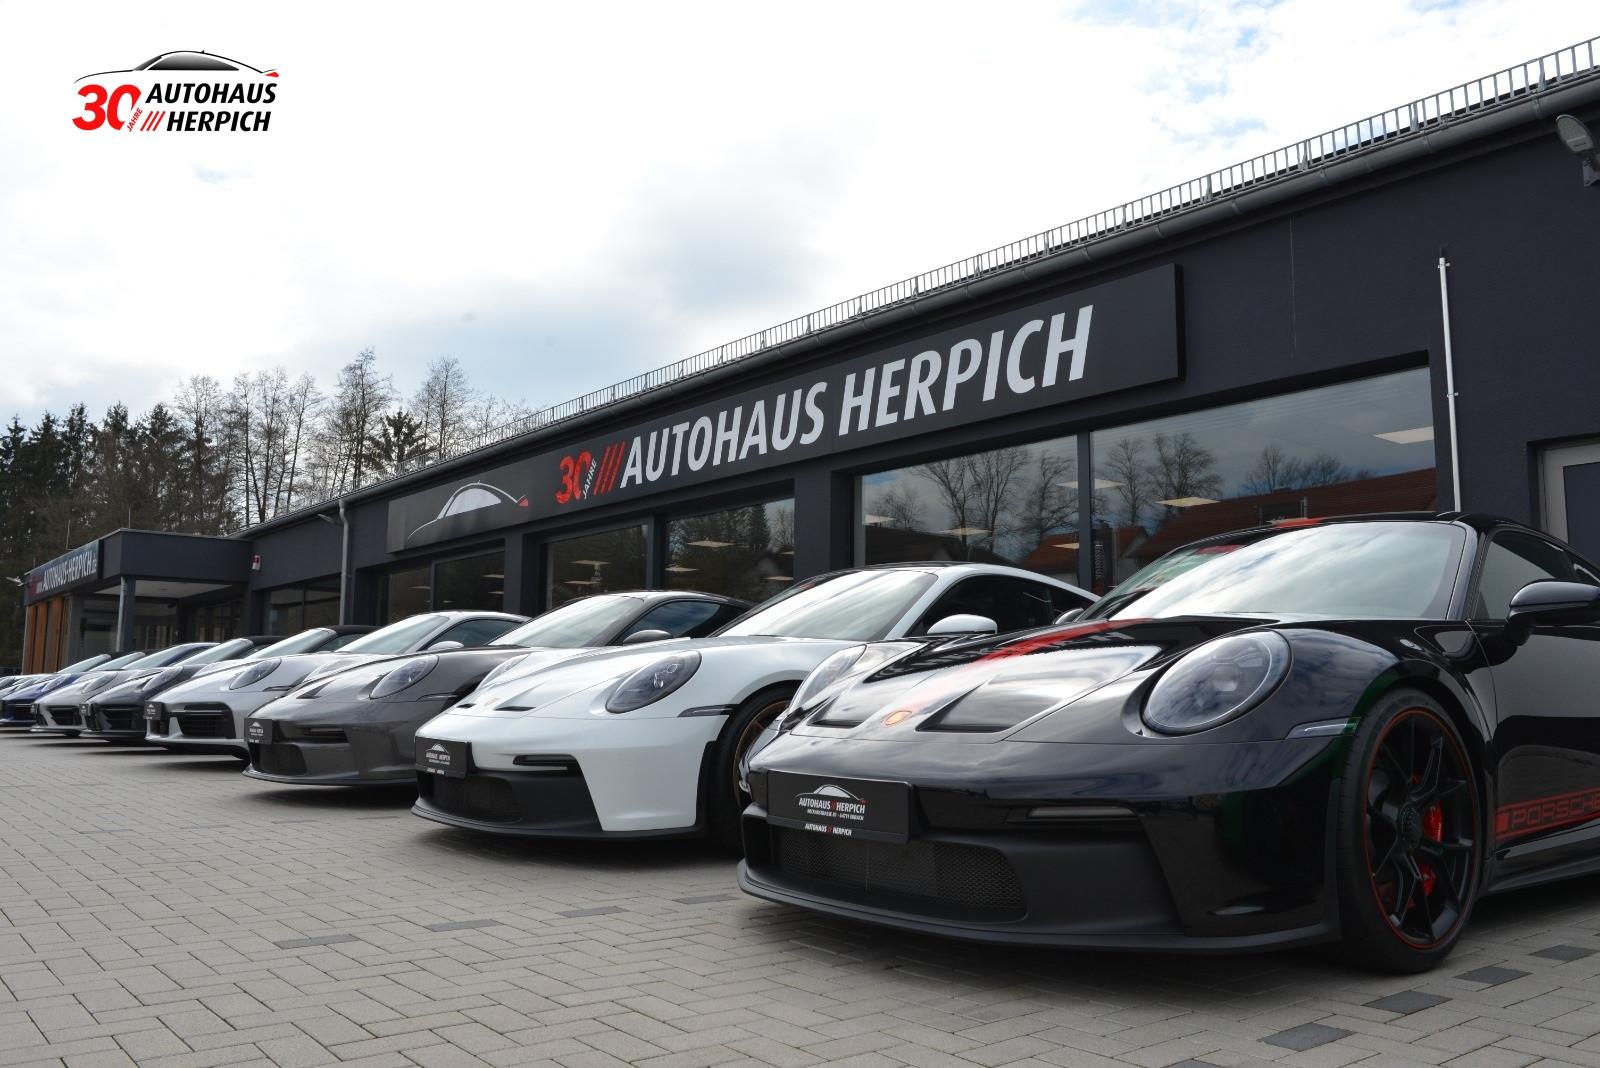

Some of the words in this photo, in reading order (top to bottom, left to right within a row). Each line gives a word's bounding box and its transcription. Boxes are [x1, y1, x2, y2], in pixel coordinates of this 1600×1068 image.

[556, 451, 592, 504] 30
[619, 381, 828, 489] AUTOHAUS
[838, 304, 1093, 436] HERPICH
[583, 458, 597, 500] JAHRE
[799, 797, 831, 810] AUTOHAUS
[836, 801, 866, 814] HERPICH
[805, 823, 828, 833] AUTOHAUS
[832, 826, 853, 836] HERPICH
